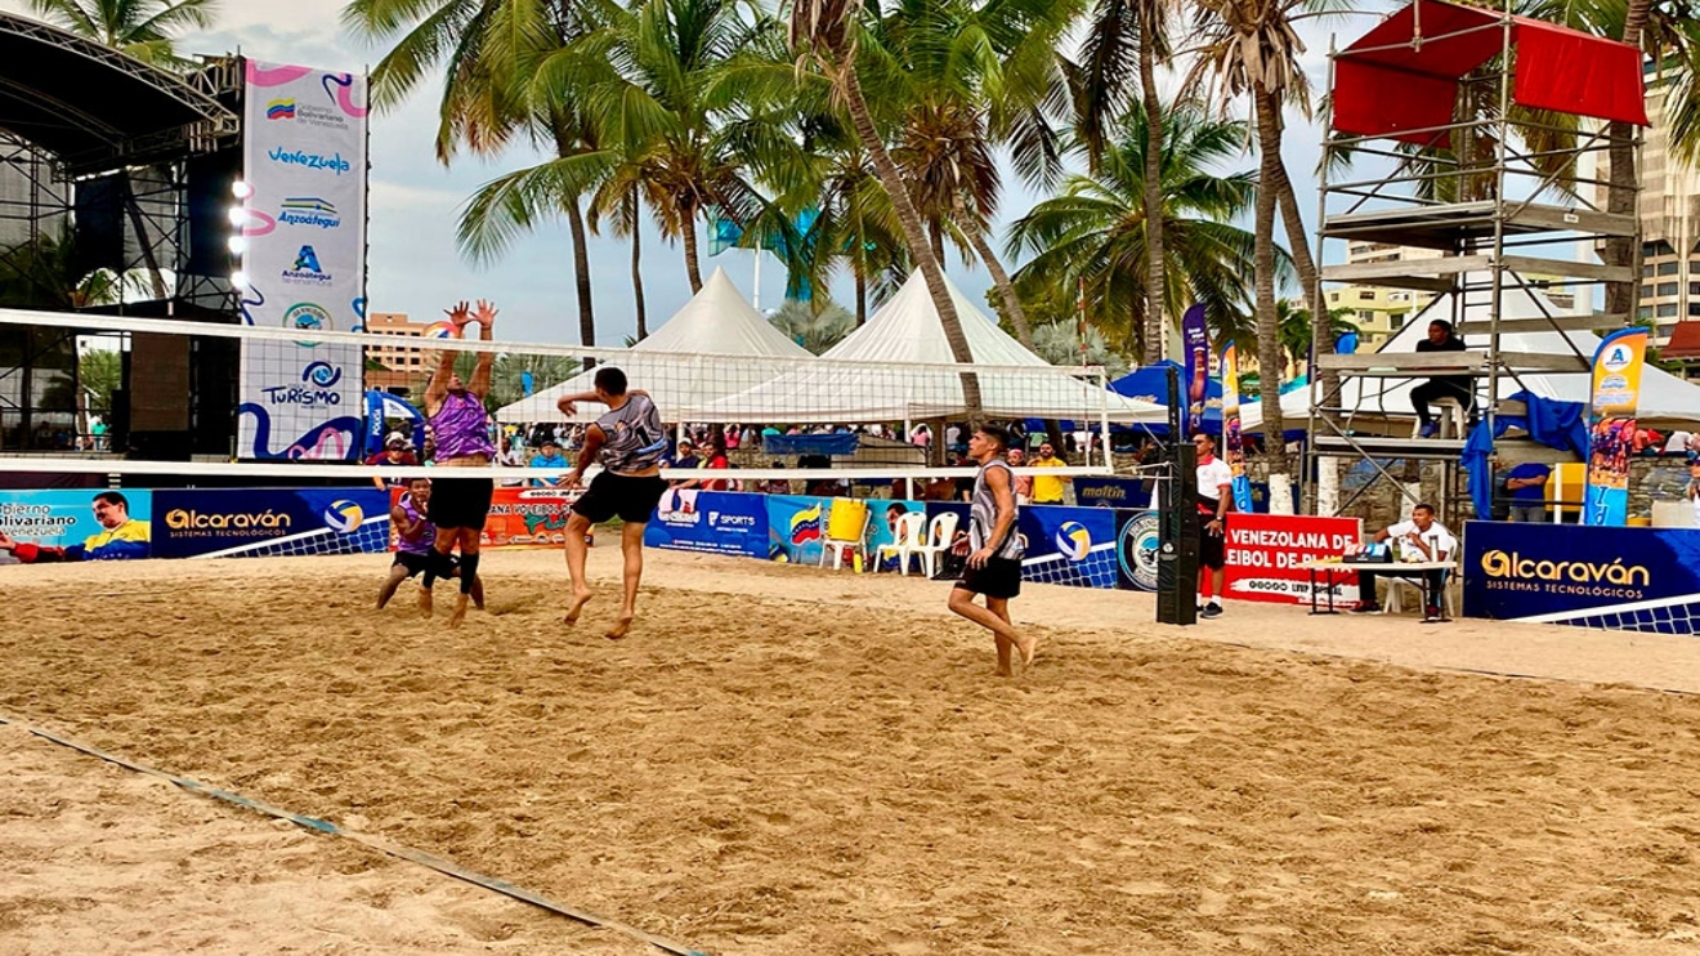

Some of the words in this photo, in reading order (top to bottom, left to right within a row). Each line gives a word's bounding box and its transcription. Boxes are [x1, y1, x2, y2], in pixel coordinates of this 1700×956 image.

[0, 504, 51, 515] bierno
[514, 504, 559, 514] VOLEIBOL
[720, 514, 755, 526] SPORTS
[170, 530, 212, 538] SISTEMAS
[215, 529, 286, 538] TECNOLÓGICOS
[1231, 530, 1328, 549] VENEZOLANA
[1332, 535, 1353, 549] DE
[1276, 552, 1297, 569] DE
[1486, 581, 1540, 592] SISTEMAS
[1545, 584, 1643, 598] TECNOLÓGICOS
